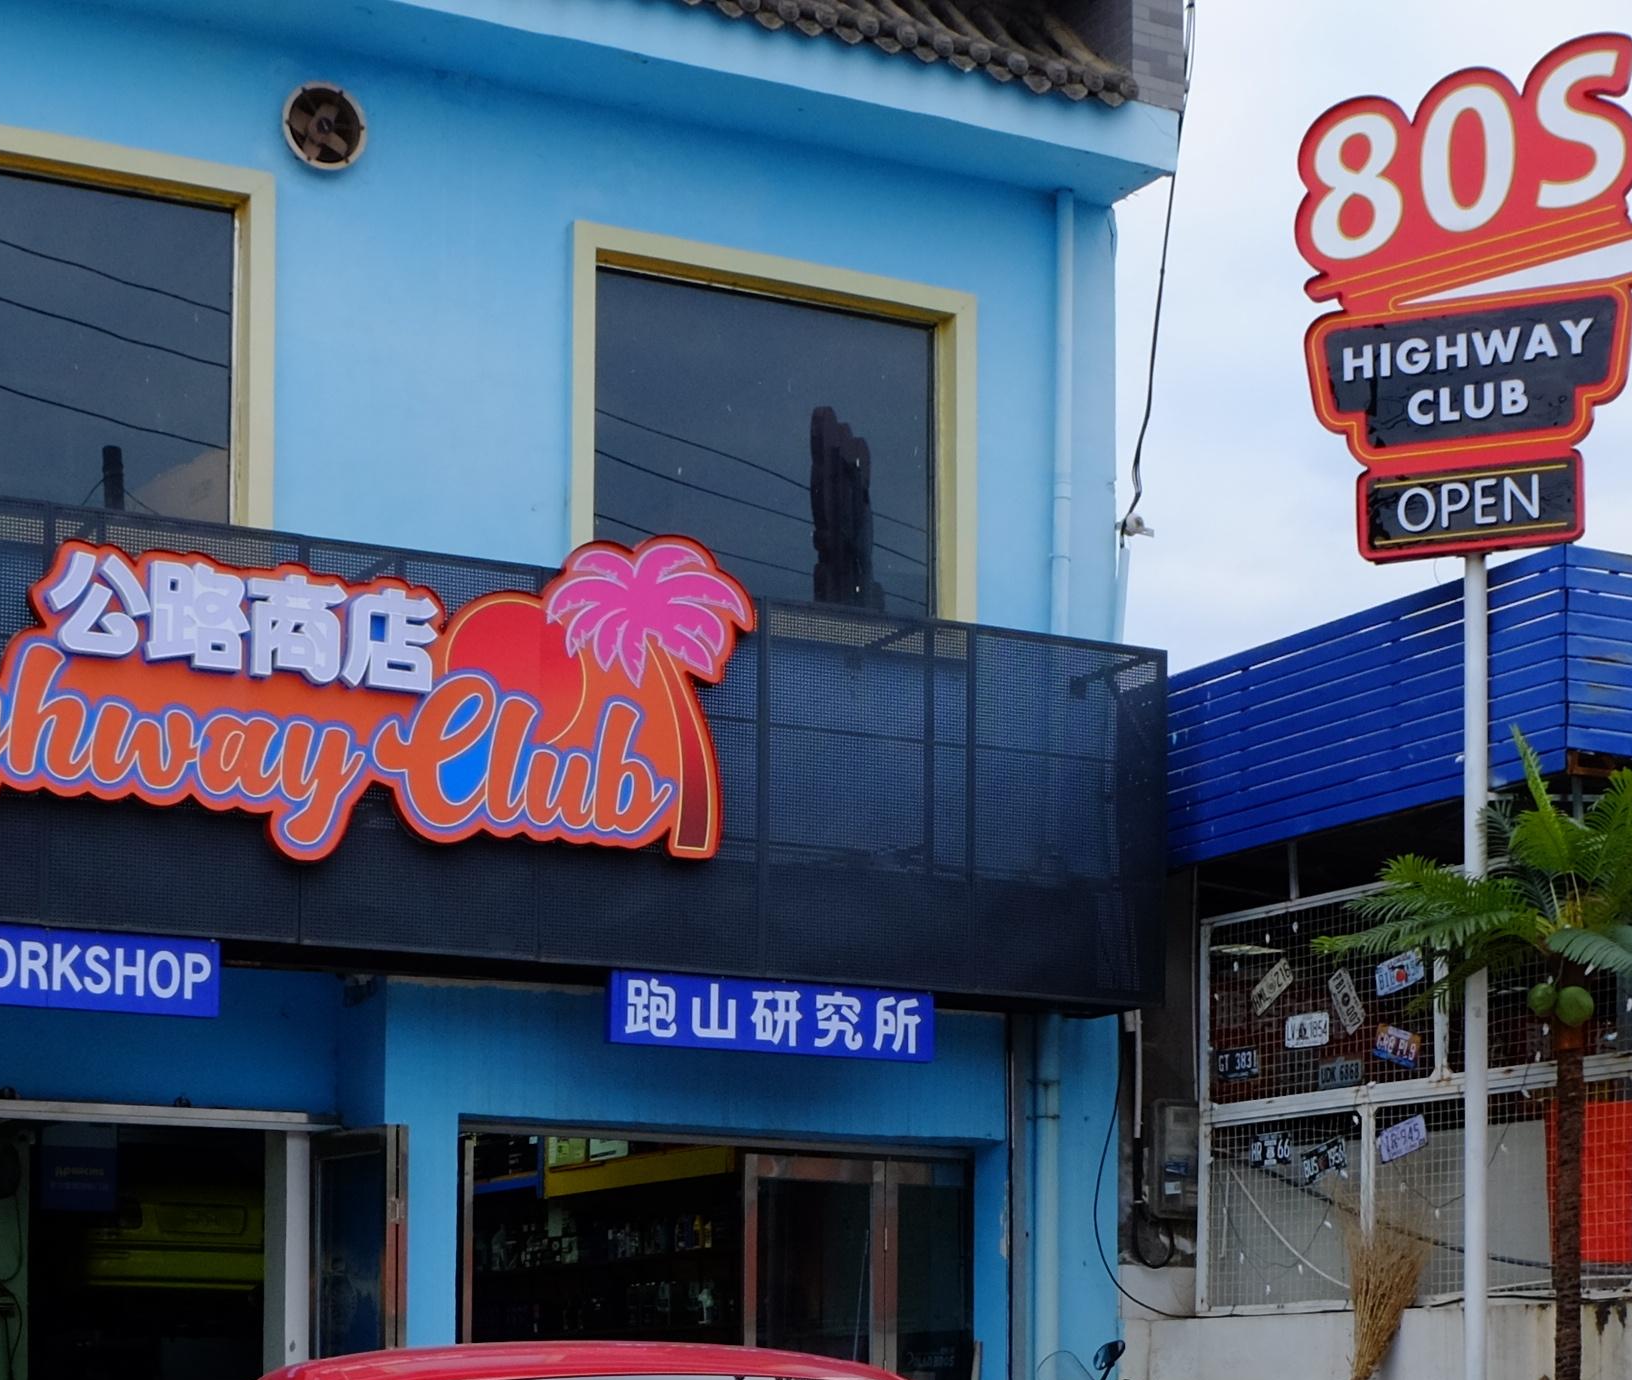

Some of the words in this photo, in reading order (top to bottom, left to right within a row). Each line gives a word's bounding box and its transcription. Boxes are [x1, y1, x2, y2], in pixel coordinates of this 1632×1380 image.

[1309, 48, 1627, 261] 80S
[1341, 317, 1595, 382] HIGHWAY
[1407, 379, 1529, 428] CLUB
[1396, 473, 1542, 534] OPEN
[49, 551, 440, 694] 公路商店
[373, 673, 674, 834] Club
[624, 977, 922, 1055] 跑山研究所
